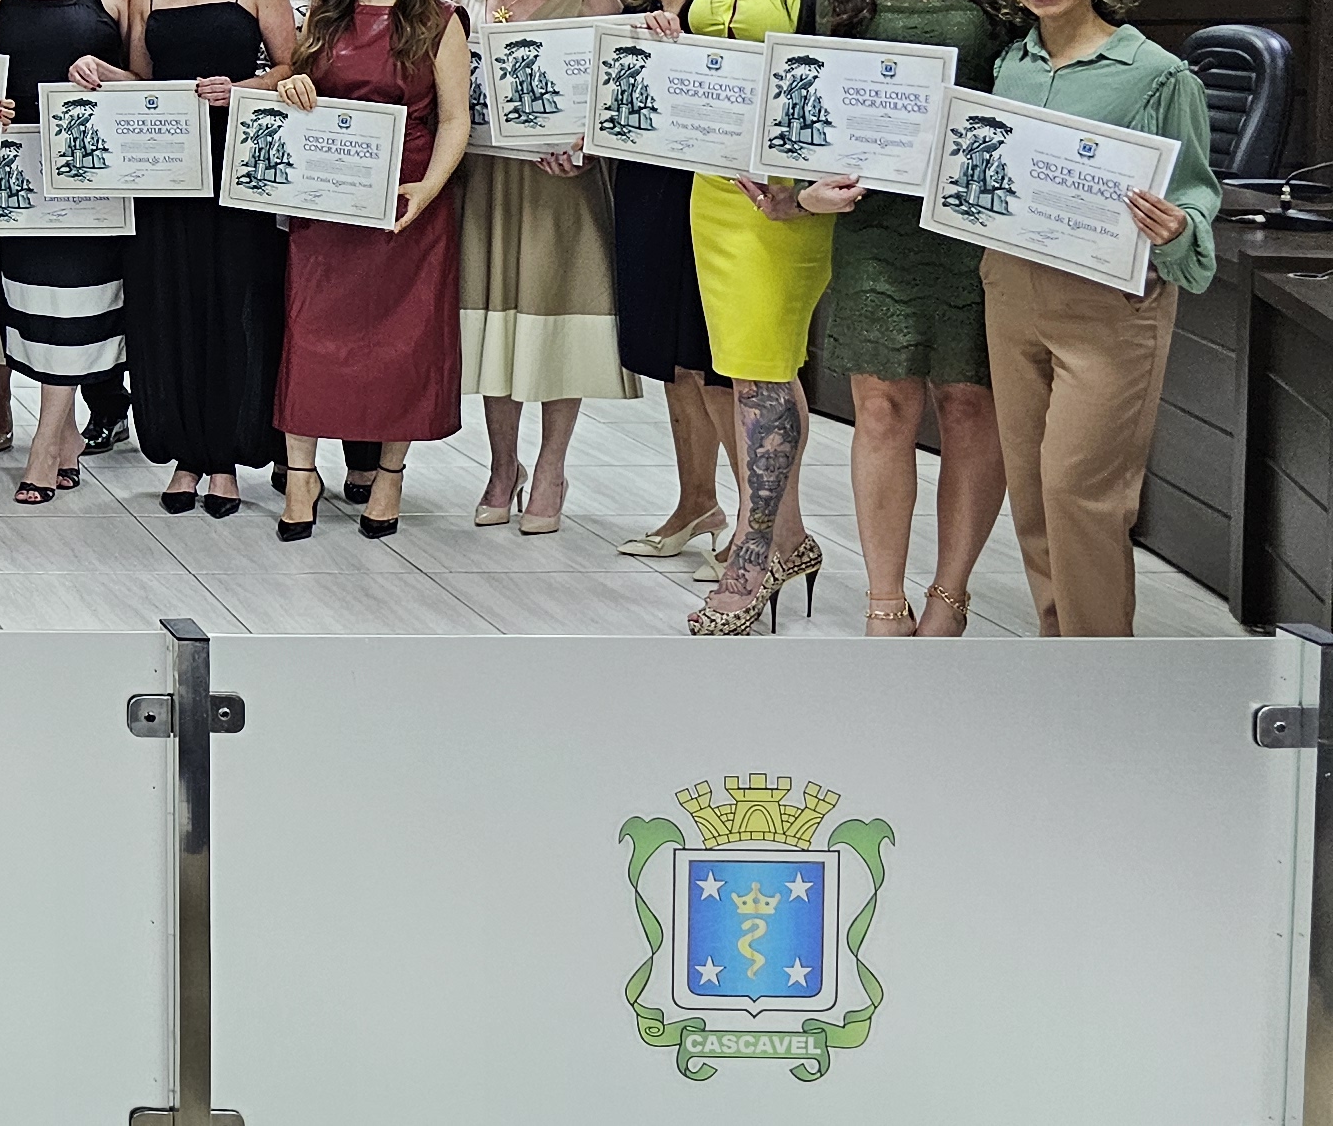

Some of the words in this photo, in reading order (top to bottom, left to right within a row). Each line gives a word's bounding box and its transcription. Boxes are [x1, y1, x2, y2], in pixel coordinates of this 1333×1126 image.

[564, 59, 587, 67] VOTO
[668, 76, 690, 87] VOTO
[693, 79, 705, 89] DE
[708, 82, 746, 95] LOUVOR
[751, 88, 756, 96] E
[668, 86, 754, 105] CONGRATULAÇÕES
[842, 86, 866, 97] VOTO
[868, 88, 882, 98] DE
[884, 91, 921, 103] LOUVOR
[925, 95, 931, 104] E
[842, 96, 928, 114] CONGRATULAÇÕES
[115, 119, 135, 127] VOTO
[137, 119, 147, 127] DE
[150, 119, 182, 127] LOUVOR
[184, 119, 190, 127] E
[115, 127, 190, 136] CONGRATULAÇÕES
[304, 134, 324, 144] VOTO
[326, 137, 337, 146] DE
[339, 139, 373, 149] LOUVOR
[122, 155, 150, 164] Fabiana
[161, 155, 183, 163] Abreu
[304, 143, 380, 160] CONGRATULAÇÕES
[1031, 158, 1058, 173] VOTO
[1060, 164, 1076, 178] DE
[1078, 170, 1123, 190] LOUVOR
[1054, 211, 1065, 224] de
[686, 1035, 821, 1054] CASCAVEL
